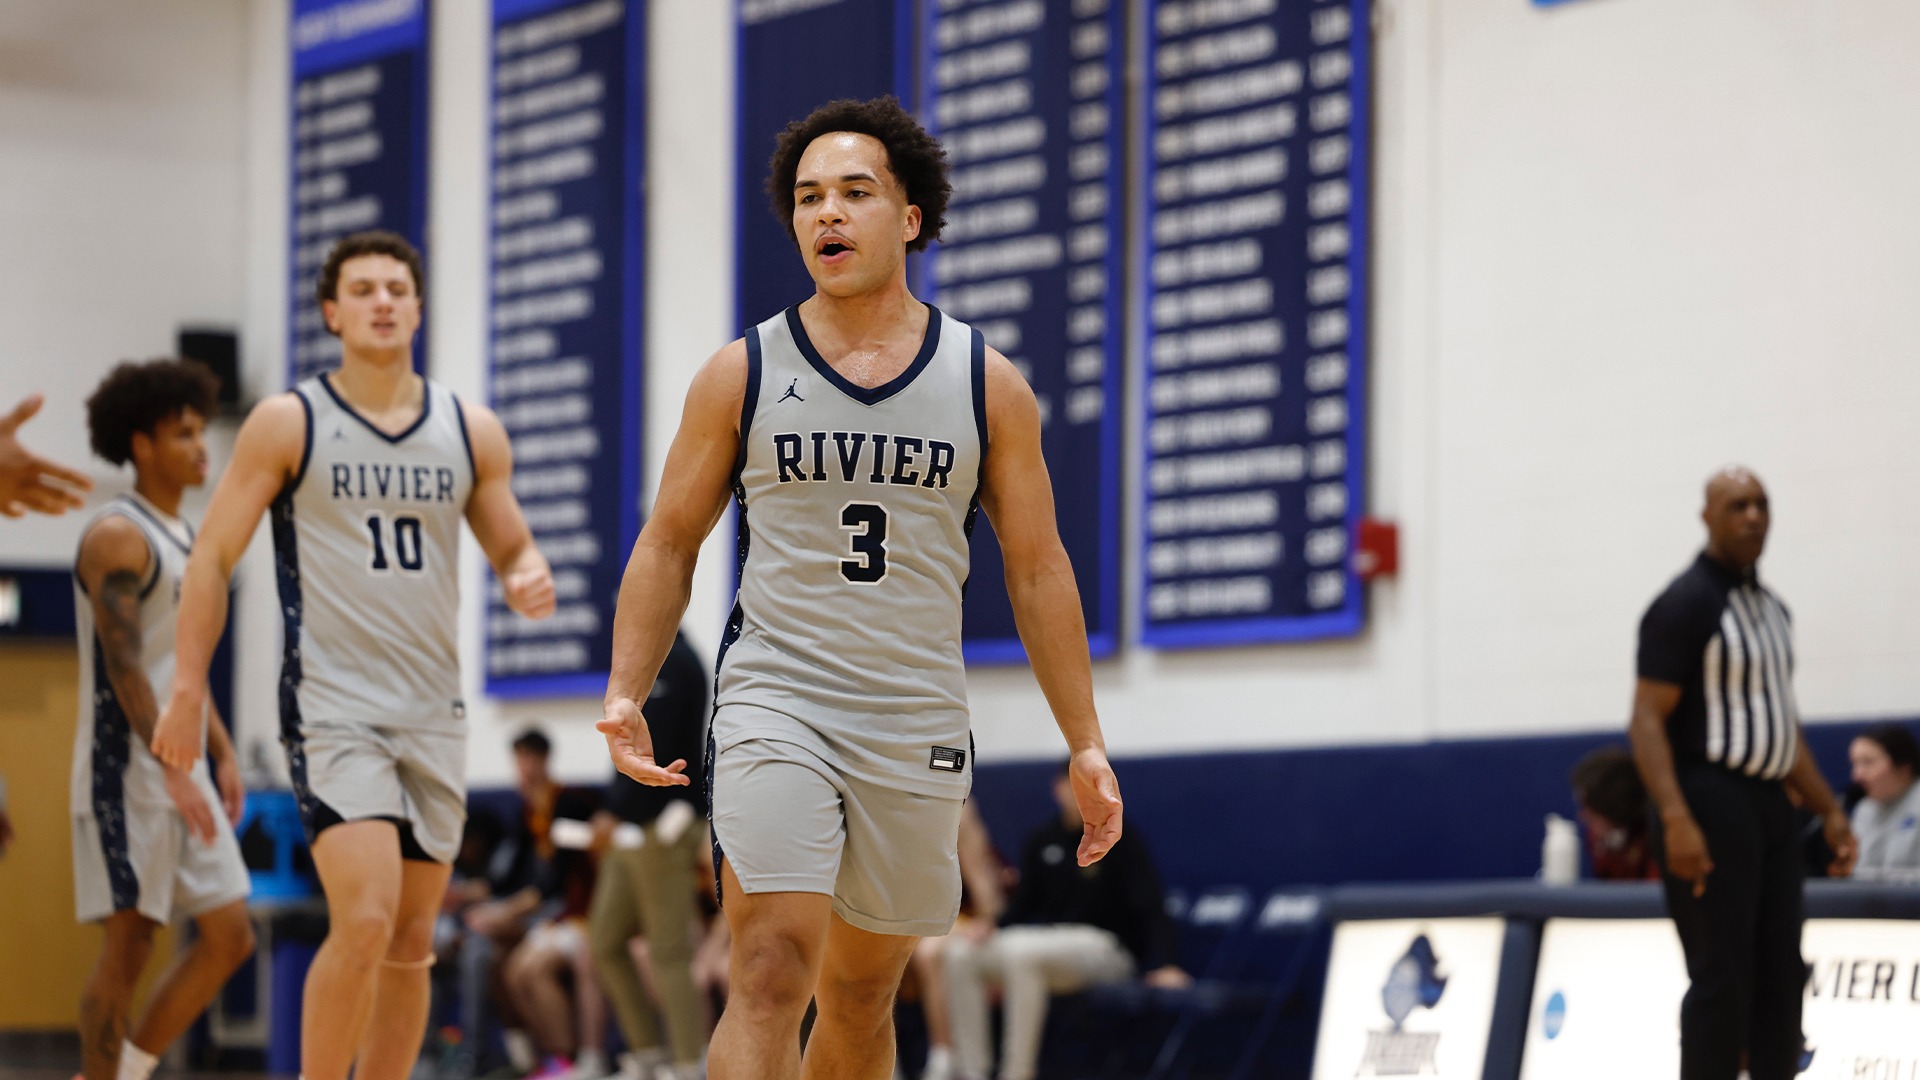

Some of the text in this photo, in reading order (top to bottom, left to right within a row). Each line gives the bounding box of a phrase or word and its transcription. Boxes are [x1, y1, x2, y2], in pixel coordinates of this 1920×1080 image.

[331, 463, 454, 502] RIVIER
[773, 430, 956, 489] RIVIER
[365, 512, 426, 574] 10
[838, 500, 891, 586] 3
